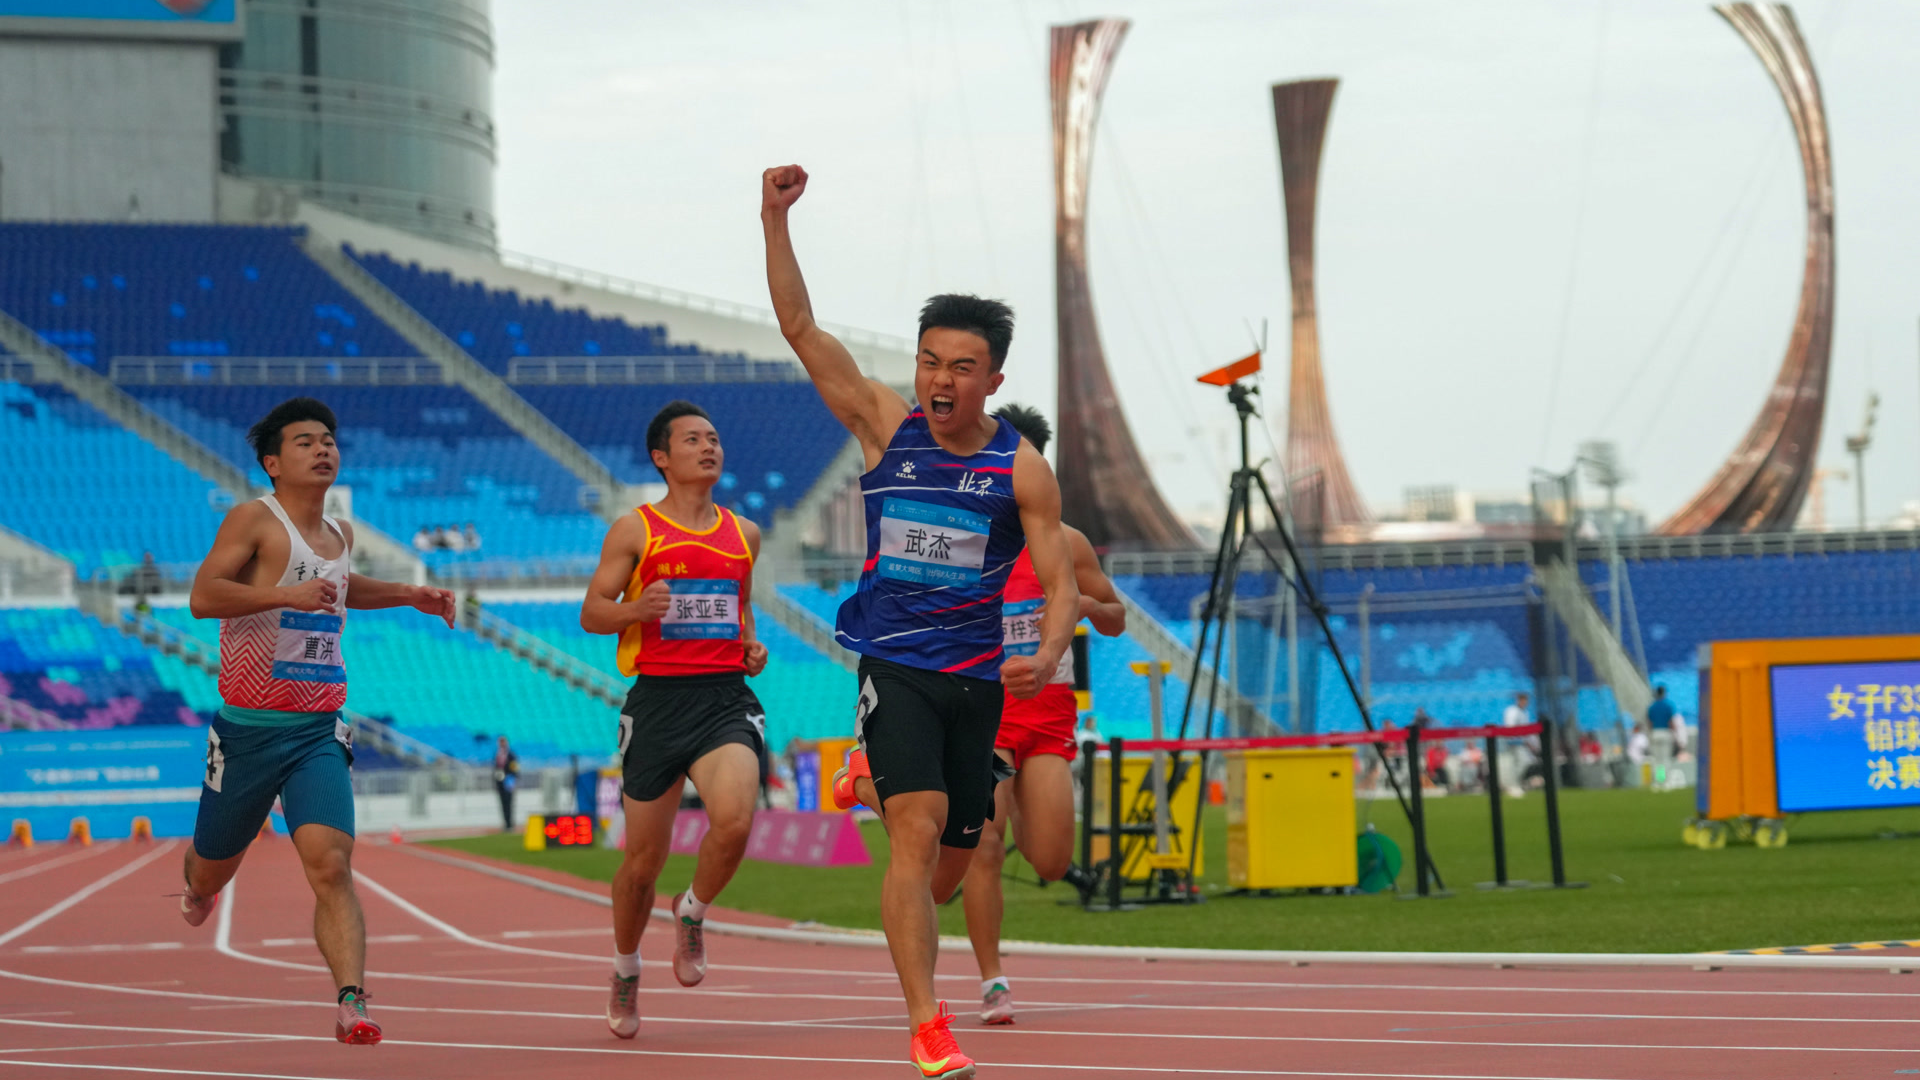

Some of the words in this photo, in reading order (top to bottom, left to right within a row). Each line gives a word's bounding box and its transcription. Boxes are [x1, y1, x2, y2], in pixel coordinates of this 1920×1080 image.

[896, 472, 917, 481] KELME
[957, 472, 994, 497] 北京
[904, 528, 953, 560] 武杰
[676, 598, 729, 620] 张亚军
[304, 635, 335, 661] 曹洪
[1864, 716, 1920, 752] 铅球
[1867, 754, 1920, 790] 决赛
